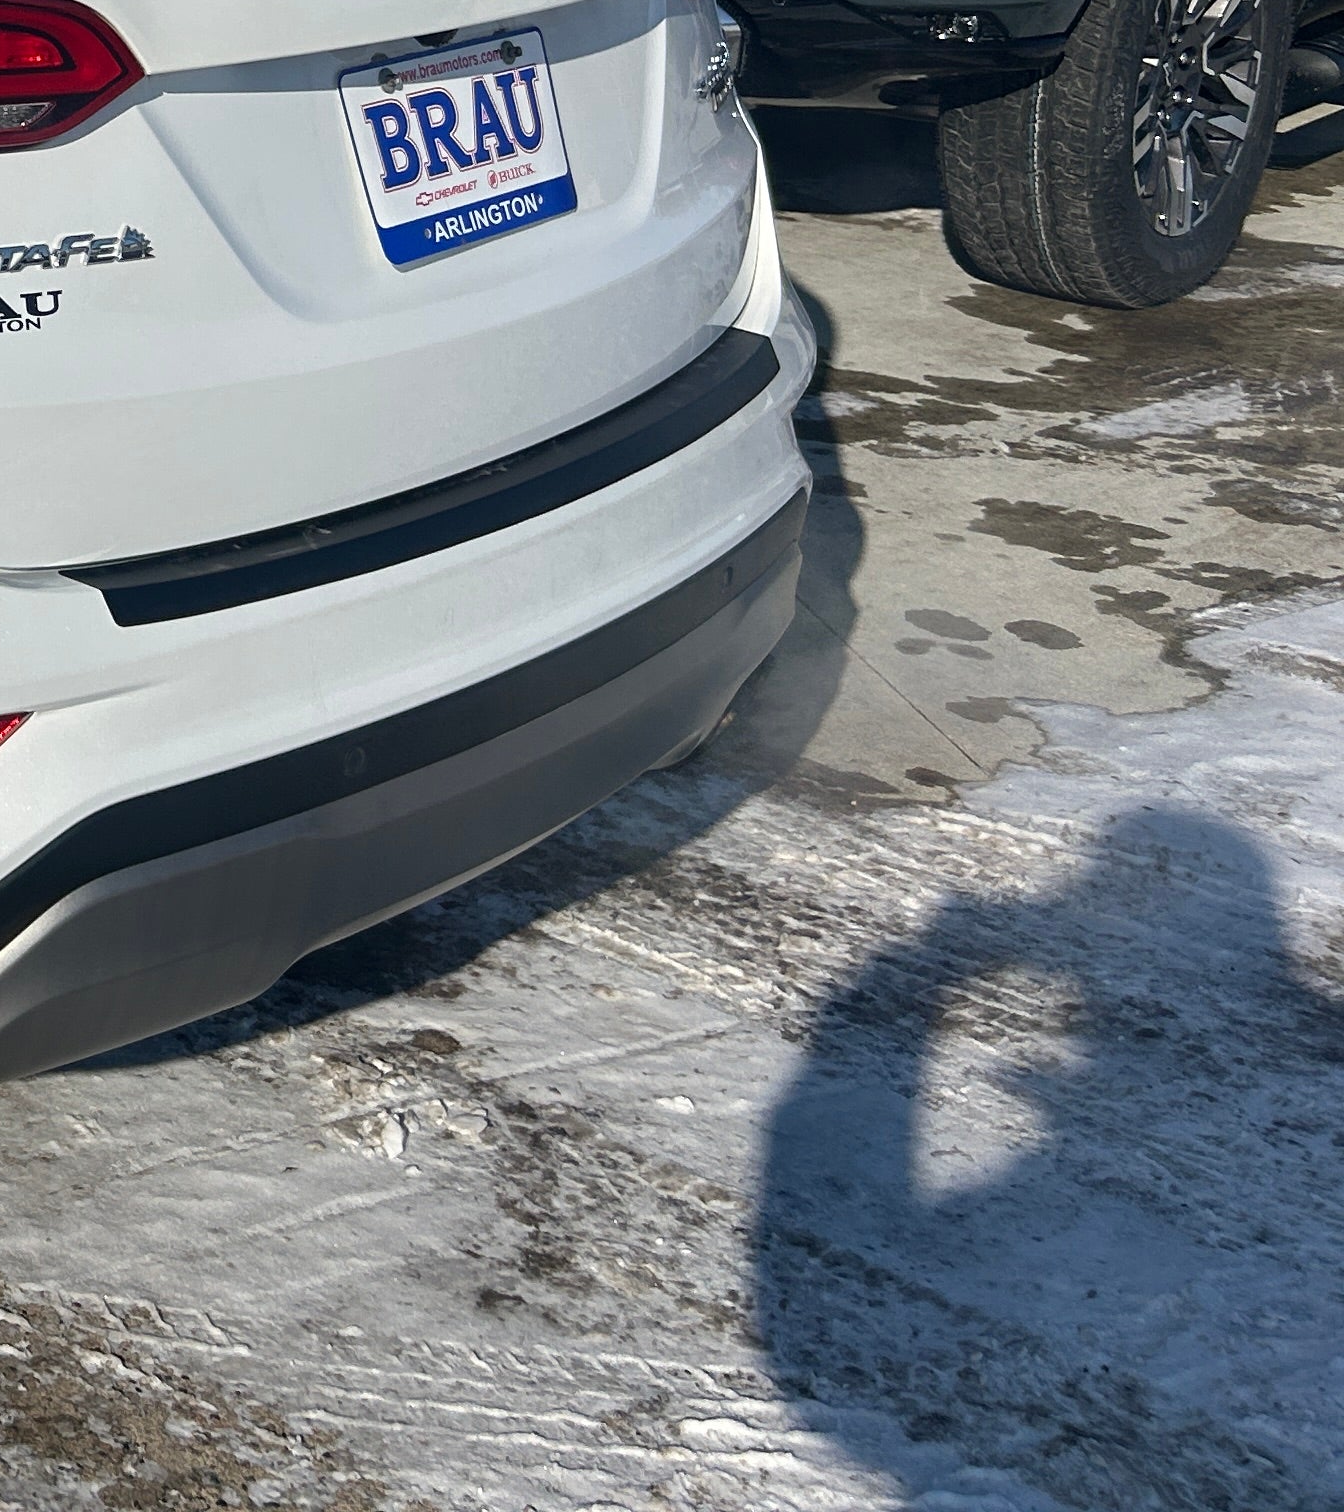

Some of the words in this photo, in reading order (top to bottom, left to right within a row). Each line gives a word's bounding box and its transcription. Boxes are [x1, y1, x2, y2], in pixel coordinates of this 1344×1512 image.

[392, 48, 503, 82] ww.braumotors.com
[361, 65, 545, 194] BRAU
[433, 179, 478, 201] CHEVROLET
[498, 163, 536, 183] BUICK
[433, 192, 539, 244] ARLINGTON
